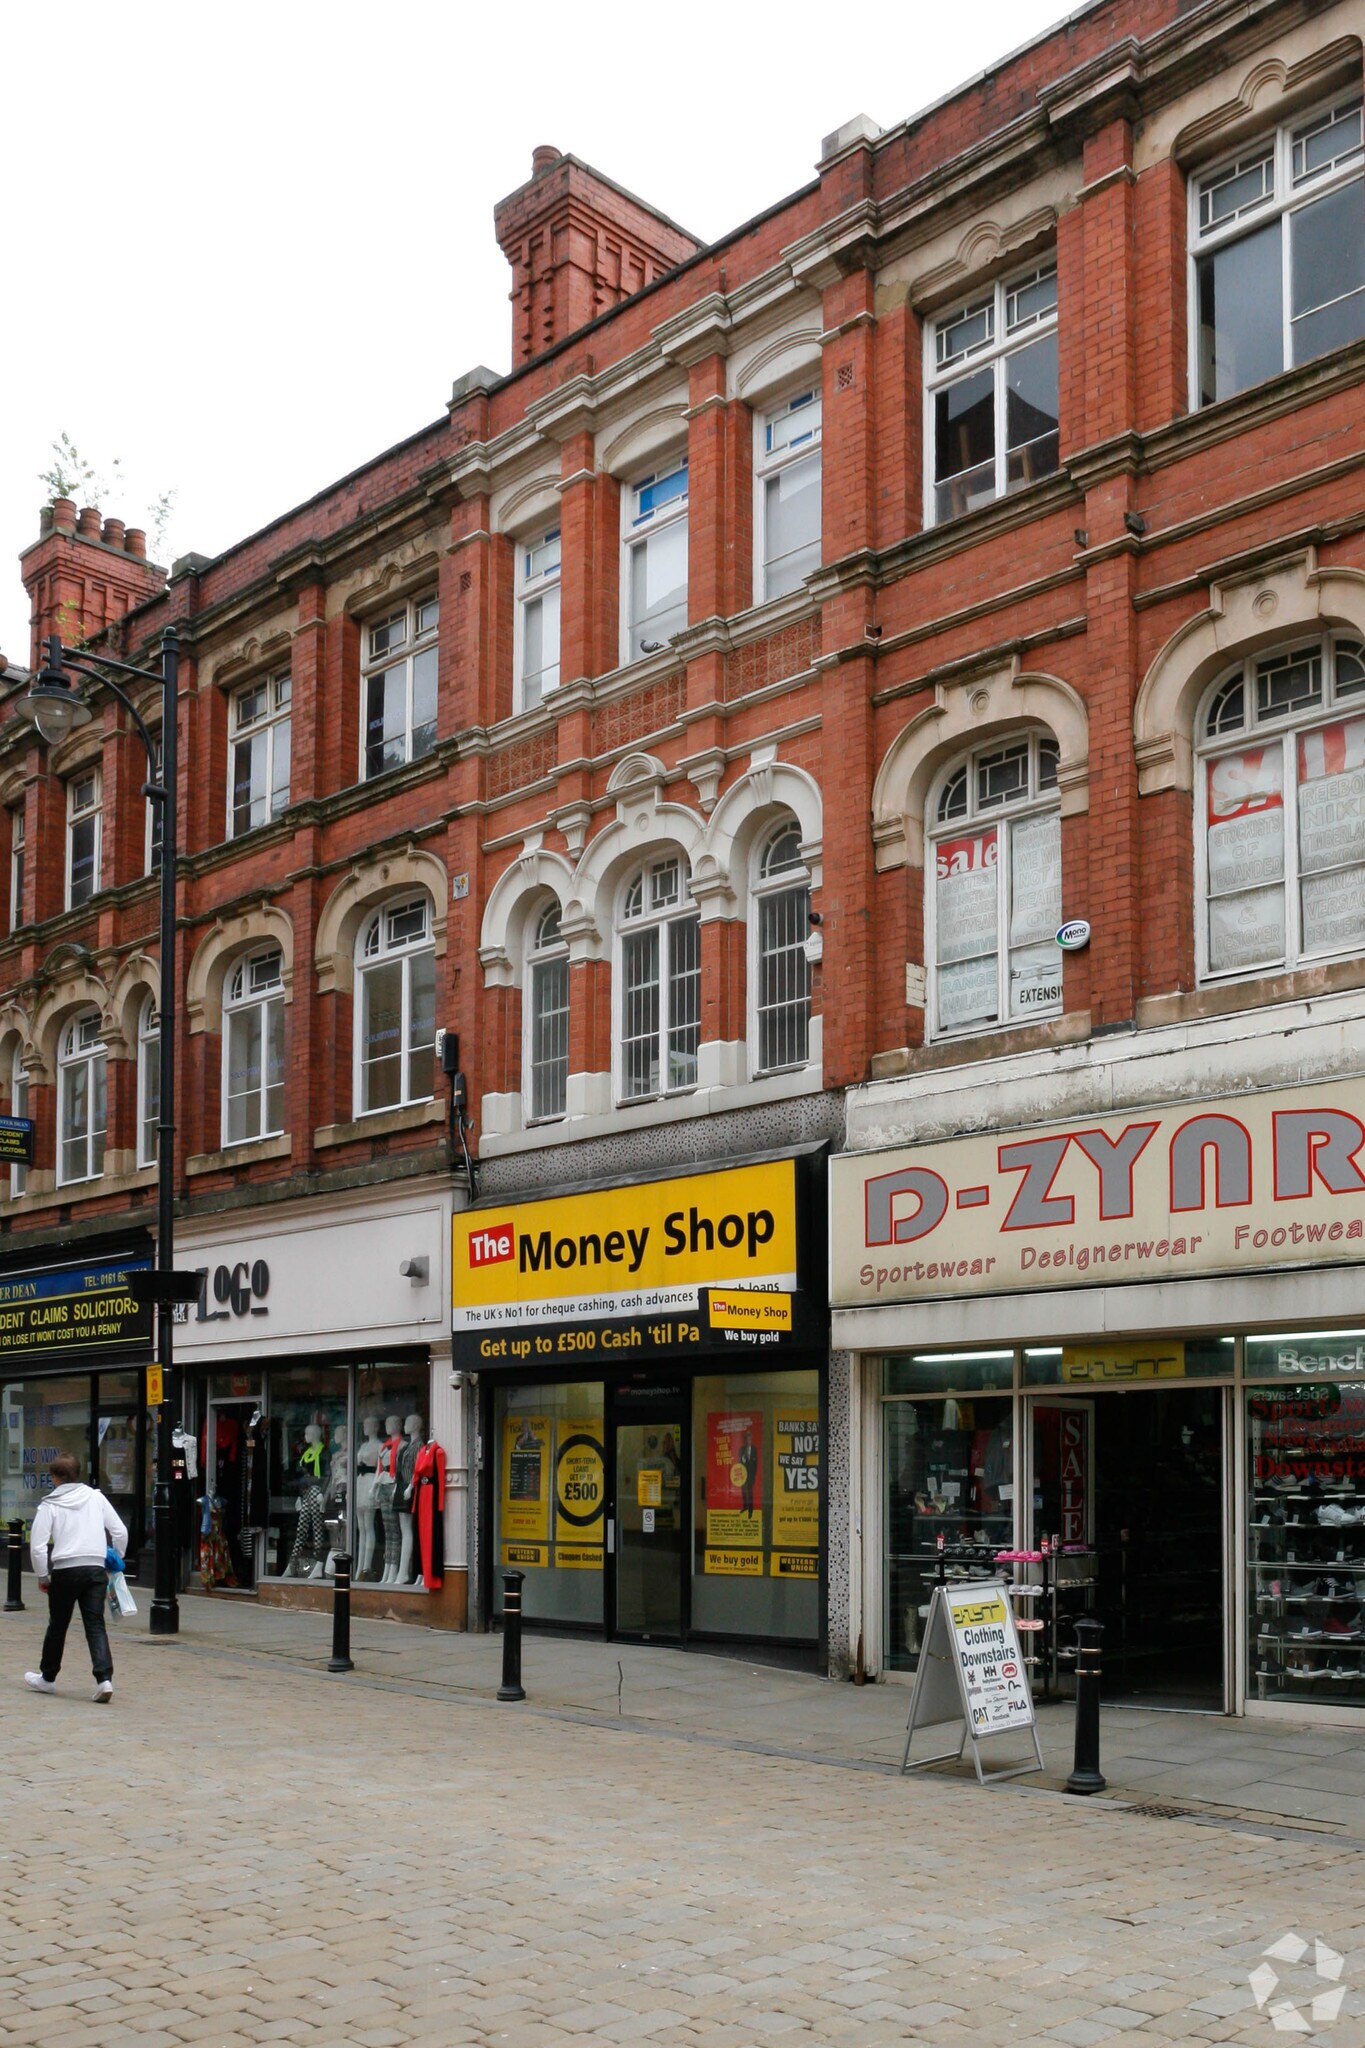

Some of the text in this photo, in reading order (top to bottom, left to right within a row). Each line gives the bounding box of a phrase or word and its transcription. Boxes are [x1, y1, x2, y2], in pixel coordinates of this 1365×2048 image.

[937, 838, 998, 880] sale
[1231, 841, 1259, 859] OF
[1215, 856, 1281, 888] BRANDED
[1064, 927, 1087, 940] Mono
[1215, 923, 1281, 954] DESIGNER
[472, 1207, 775, 1273] The Money Shop
[859, 1254, 996, 1292] Sportswear
[1020, 1234, 1203, 1271] Designerwear
[84, 1272, 116, 1288] TEL: 0161
[12, 1282, 38, 1299] DEAN
[30, 1305, 69, 1326] CLAIMS
[73, 1297, 139, 1321] SOLICITORS
[466, 1310, 481, 1322] The
[506, 1306, 522, 1319] No1
[525, 1305, 540, 1317] for
[542, 1302, 575, 1317] cheque
[578, 1298, 618, 1313] cashing,
[621, 1295, 643, 1308] cash
[645, 1292, 694, 1306] advances
[713, 1302, 788, 1320] The Money Shop
[2, 1322, 122, 1346] OR LOSE IT WONT COST YOU A PENNY
[480, 1339, 507, 1358] Get
[511, 1340, 531, 1359] up
[535, 1338, 552, 1353] to
[557, 1331, 596, 1351] £500
[601, 1328, 642, 1348] Cash
[648, 1325, 672, 1345] 'til
[724, 1330, 780, 1345] We buy gold
[779, 1420, 819, 1433] BANKS SA
[23, 1448, 37, 1464] NO
[779, 1455, 805, 1466] WE SAY
[23, 1473, 37, 1489] NO
[785, 1468, 819, 1490] YES
[564, 1482, 598, 1501] £500
[709, 1554, 759, 1567] We buy gold
[780, 1557, 815, 1566] WESTERN
[790, 1564, 815, 1572] UNION
[964, 1626, 1005, 1646] Clothing
[961, 1645, 1016, 1667] Downstairs
[1008, 1700, 1027, 1711] FILA
[973, 1706, 989, 1724] CAT
